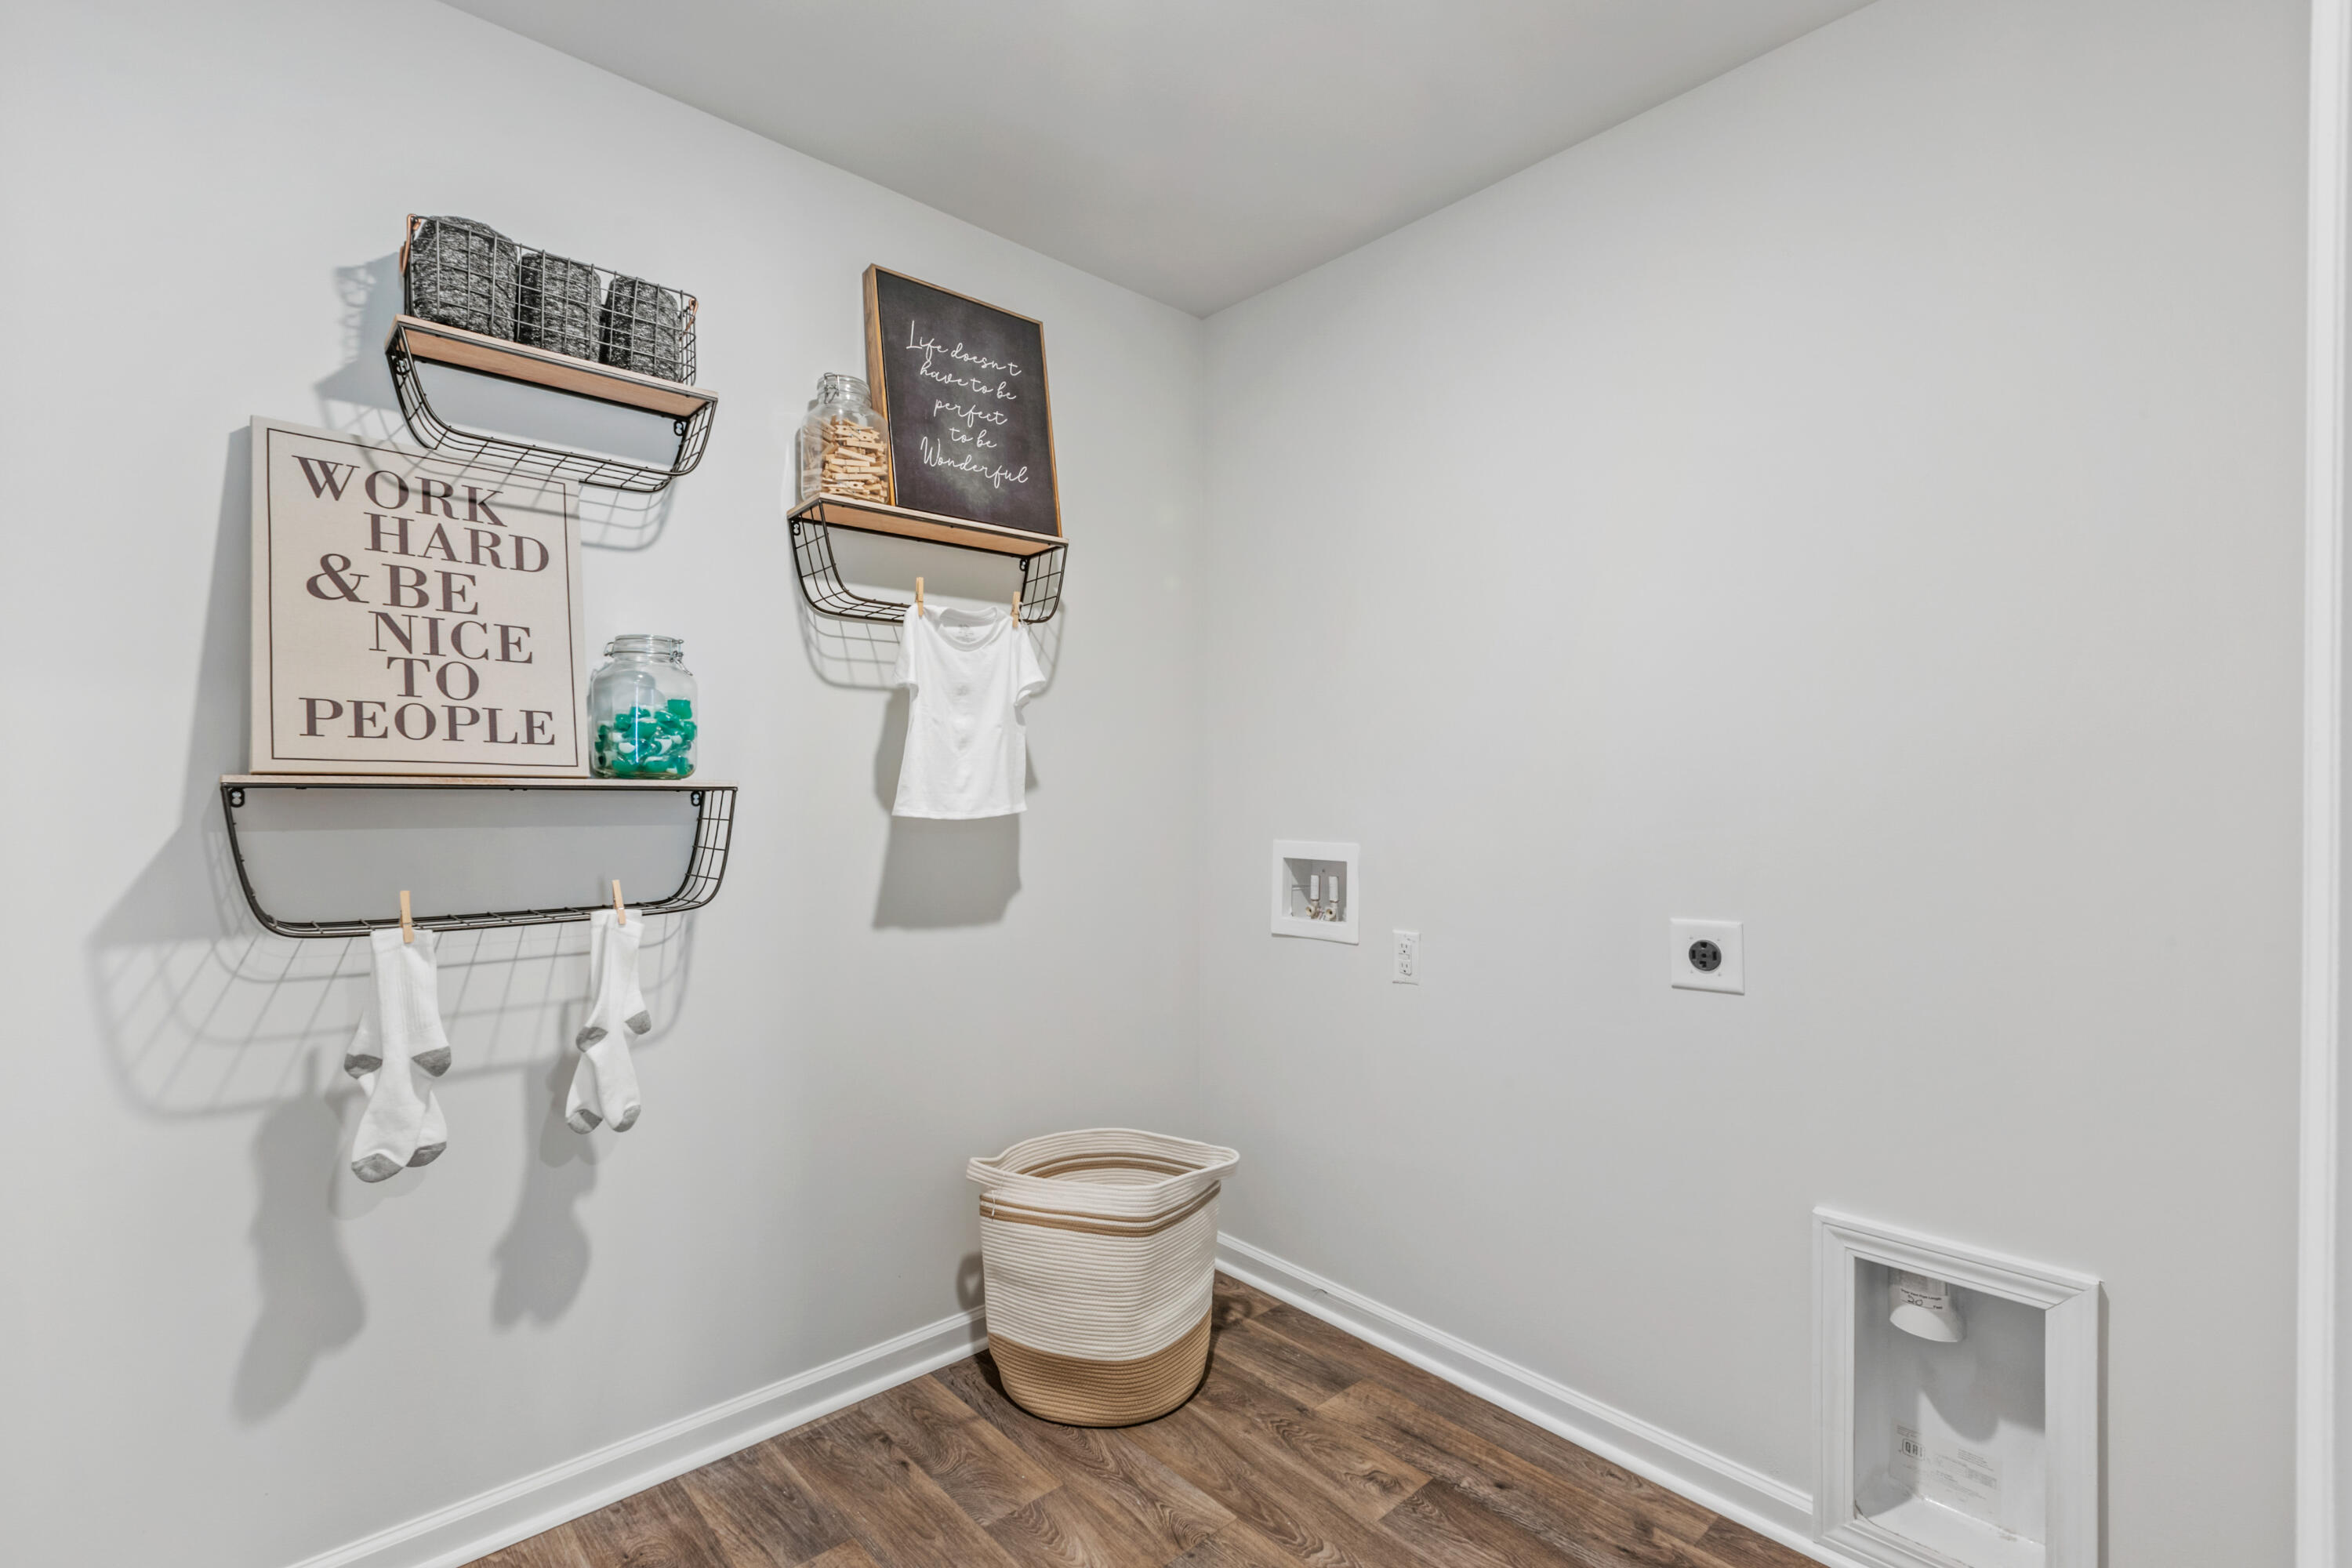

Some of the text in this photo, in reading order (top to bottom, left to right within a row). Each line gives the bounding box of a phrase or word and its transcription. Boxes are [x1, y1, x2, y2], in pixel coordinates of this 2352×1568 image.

[906, 320, 949, 361] Life
[920, 360, 1016, 400] have to be
[933, 399, 1008, 428] perfect
[949, 426, 997, 448] to be
[920, 436, 1029, 488] Wonderful
[291, 455, 508, 528] WORK
[363, 511, 550, 573] HARD
[306, 554, 479, 615] & BE
[368, 610, 533, 664] NICE
[387, 655, 480, 702] TO
[298, 697, 555, 746] PEOPLE
